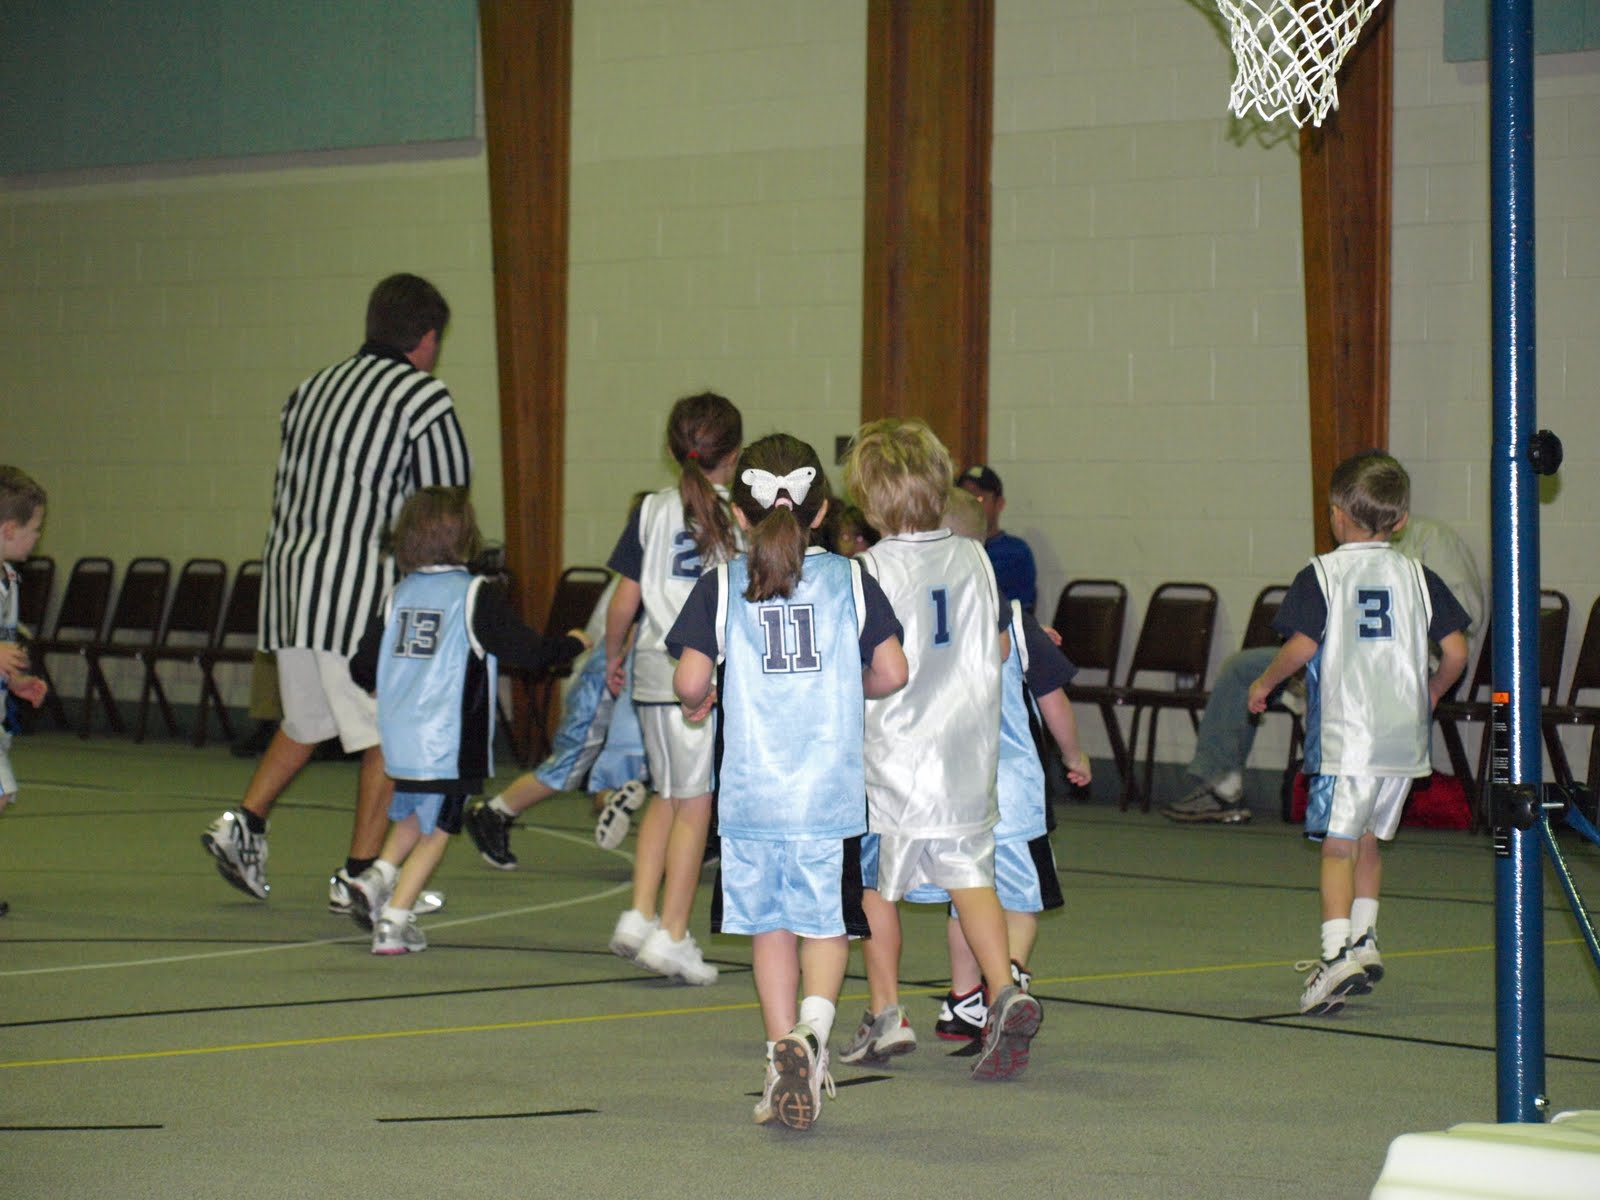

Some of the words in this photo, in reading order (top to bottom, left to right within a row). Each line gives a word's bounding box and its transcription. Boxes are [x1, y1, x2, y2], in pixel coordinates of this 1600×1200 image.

[669, 529, 703, 579] 2
[392, 608, 443, 659] 13
[759, 604, 822, 673] 11
[929, 585, 951, 647] 1
[1356, 587, 1394, 640] 3
